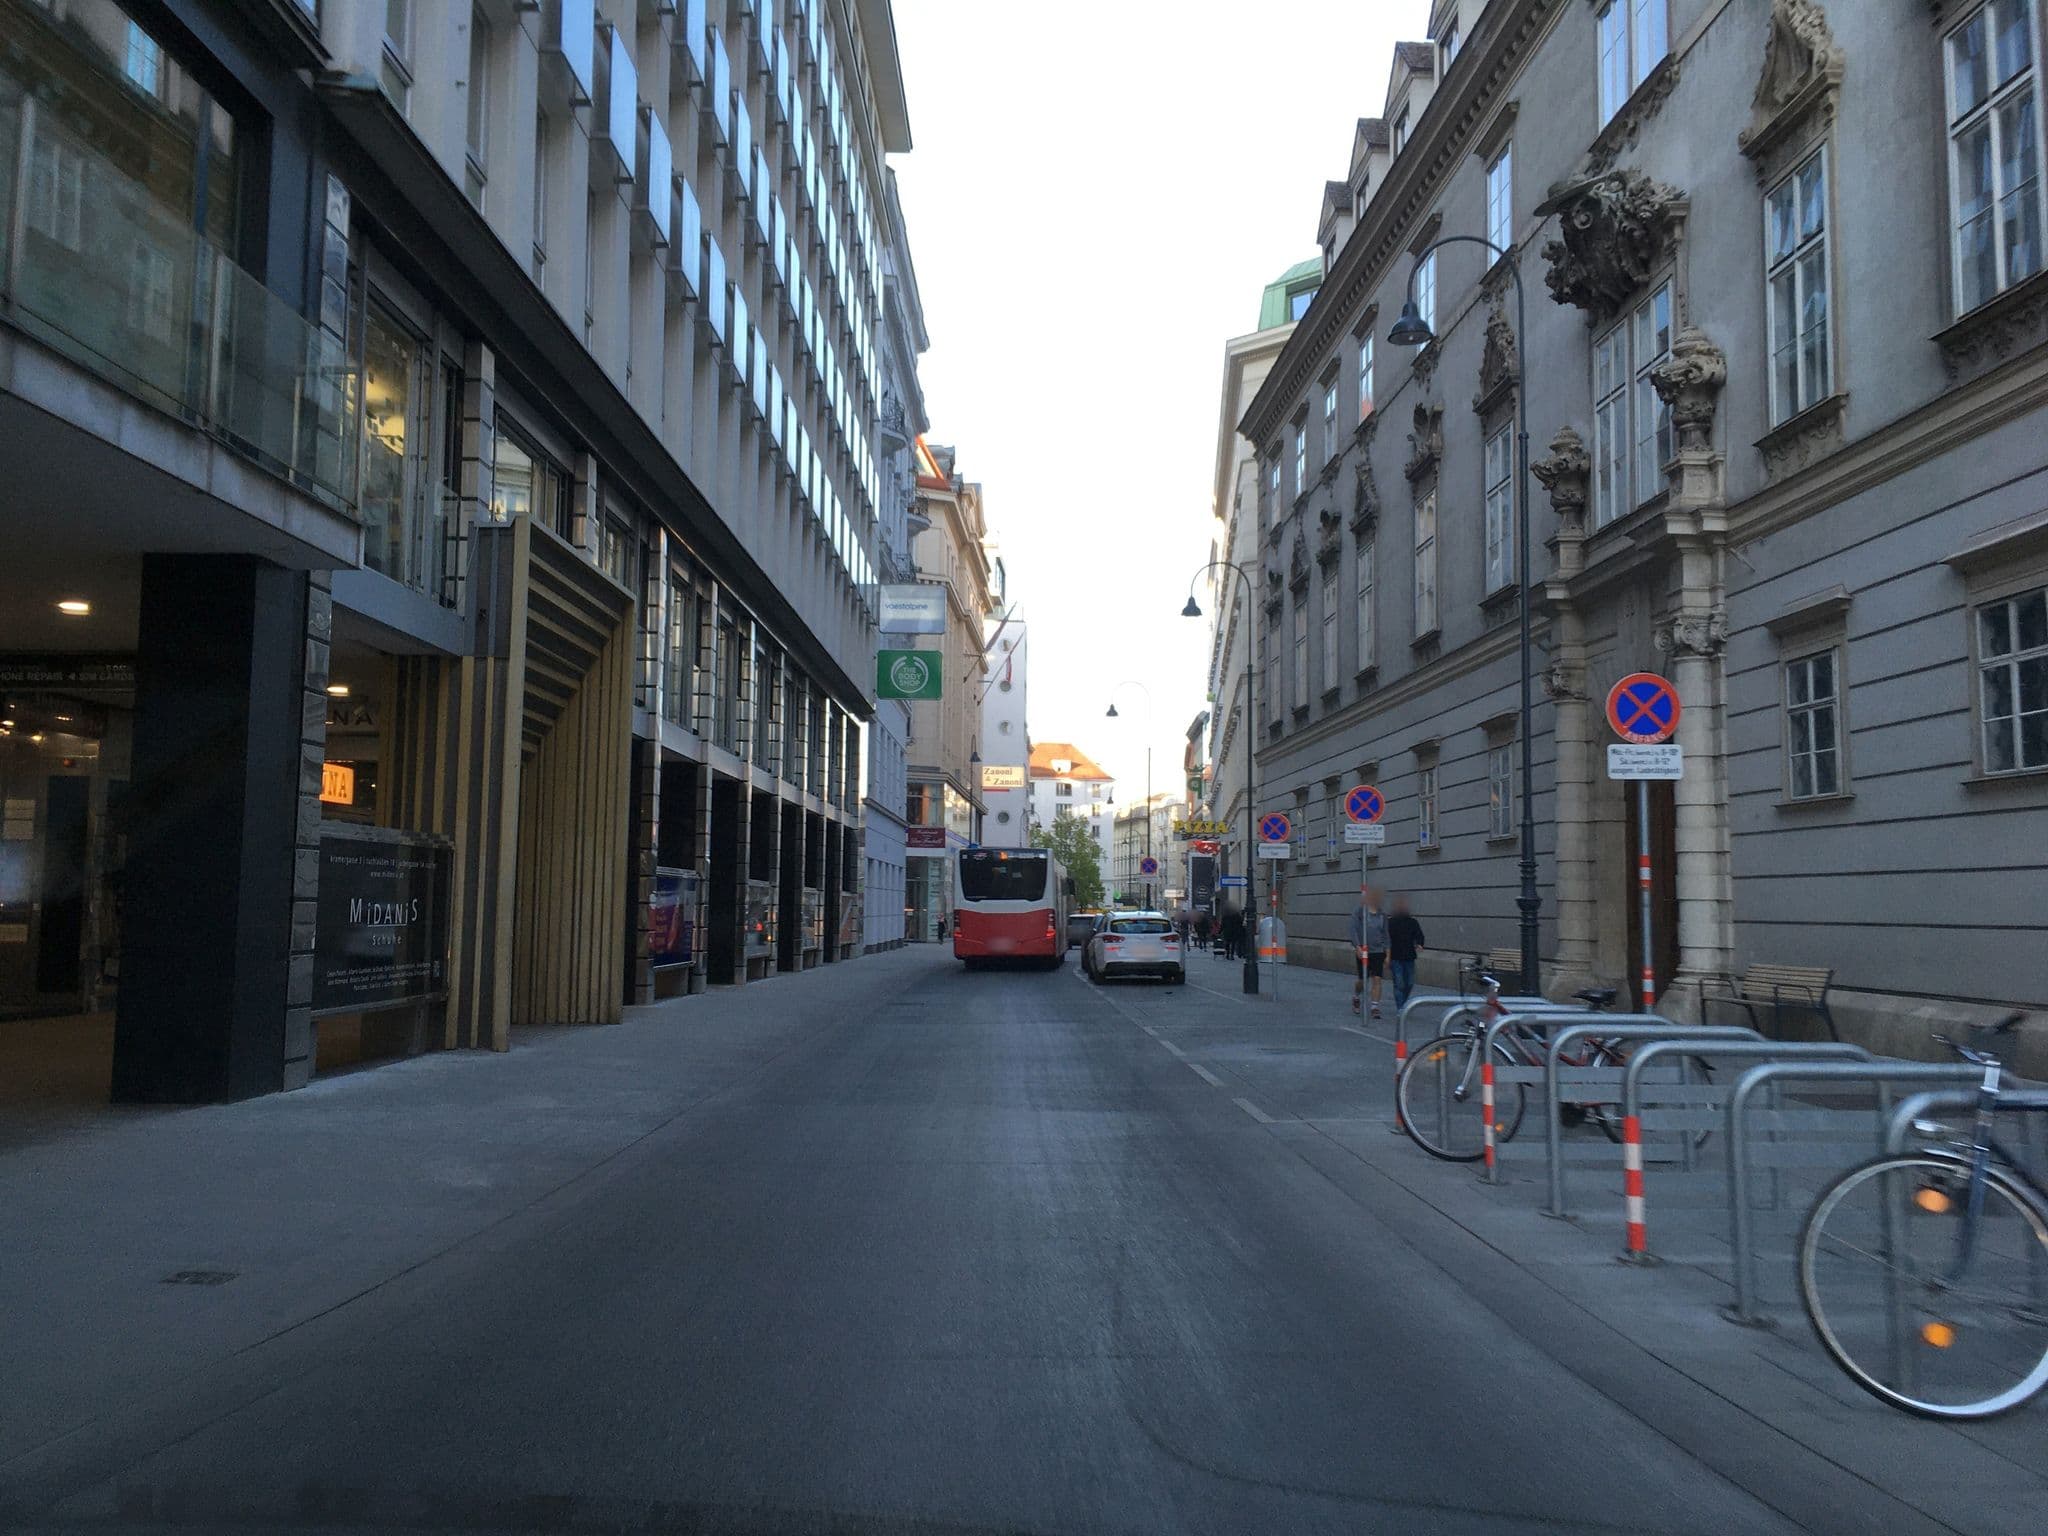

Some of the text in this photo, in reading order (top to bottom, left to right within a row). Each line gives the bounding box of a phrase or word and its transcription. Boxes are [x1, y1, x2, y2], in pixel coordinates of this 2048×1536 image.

[984, 767, 1013, 776] Zanoni
[993, 777, 1024, 786] Zanoni
[1173, 820, 1230, 833] PIZZA
